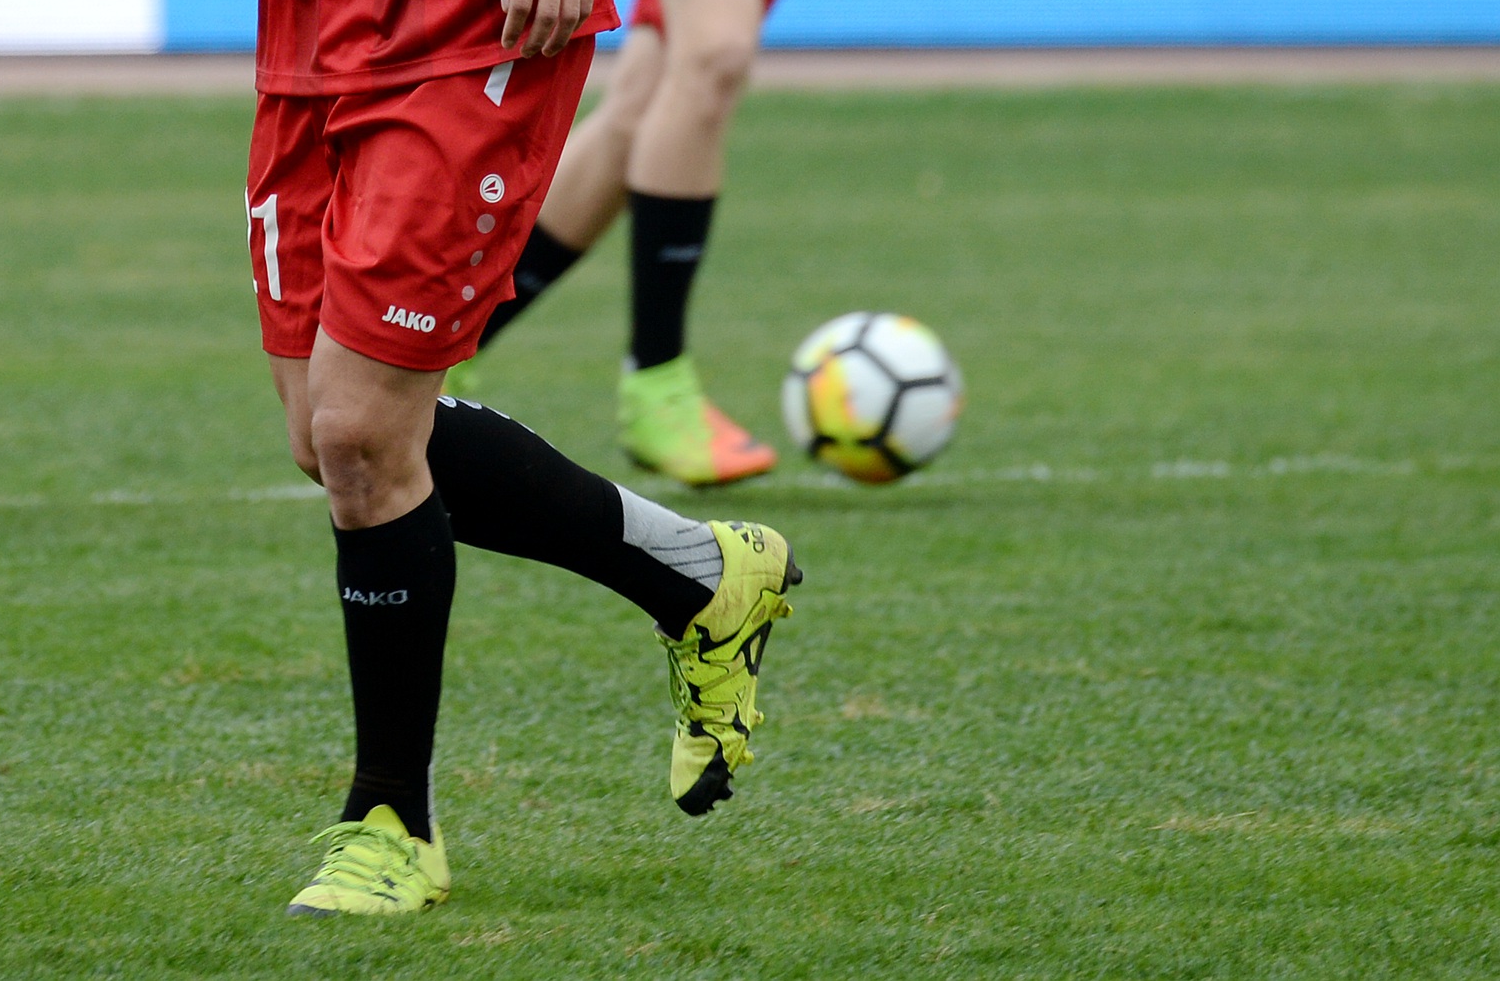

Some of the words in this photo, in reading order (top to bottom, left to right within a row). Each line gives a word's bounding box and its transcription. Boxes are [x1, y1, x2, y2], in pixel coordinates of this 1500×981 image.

[245, 185, 282, 302] 1
[382, 305, 436, 333] JAKO
[343, 587, 408, 606] JAKO
